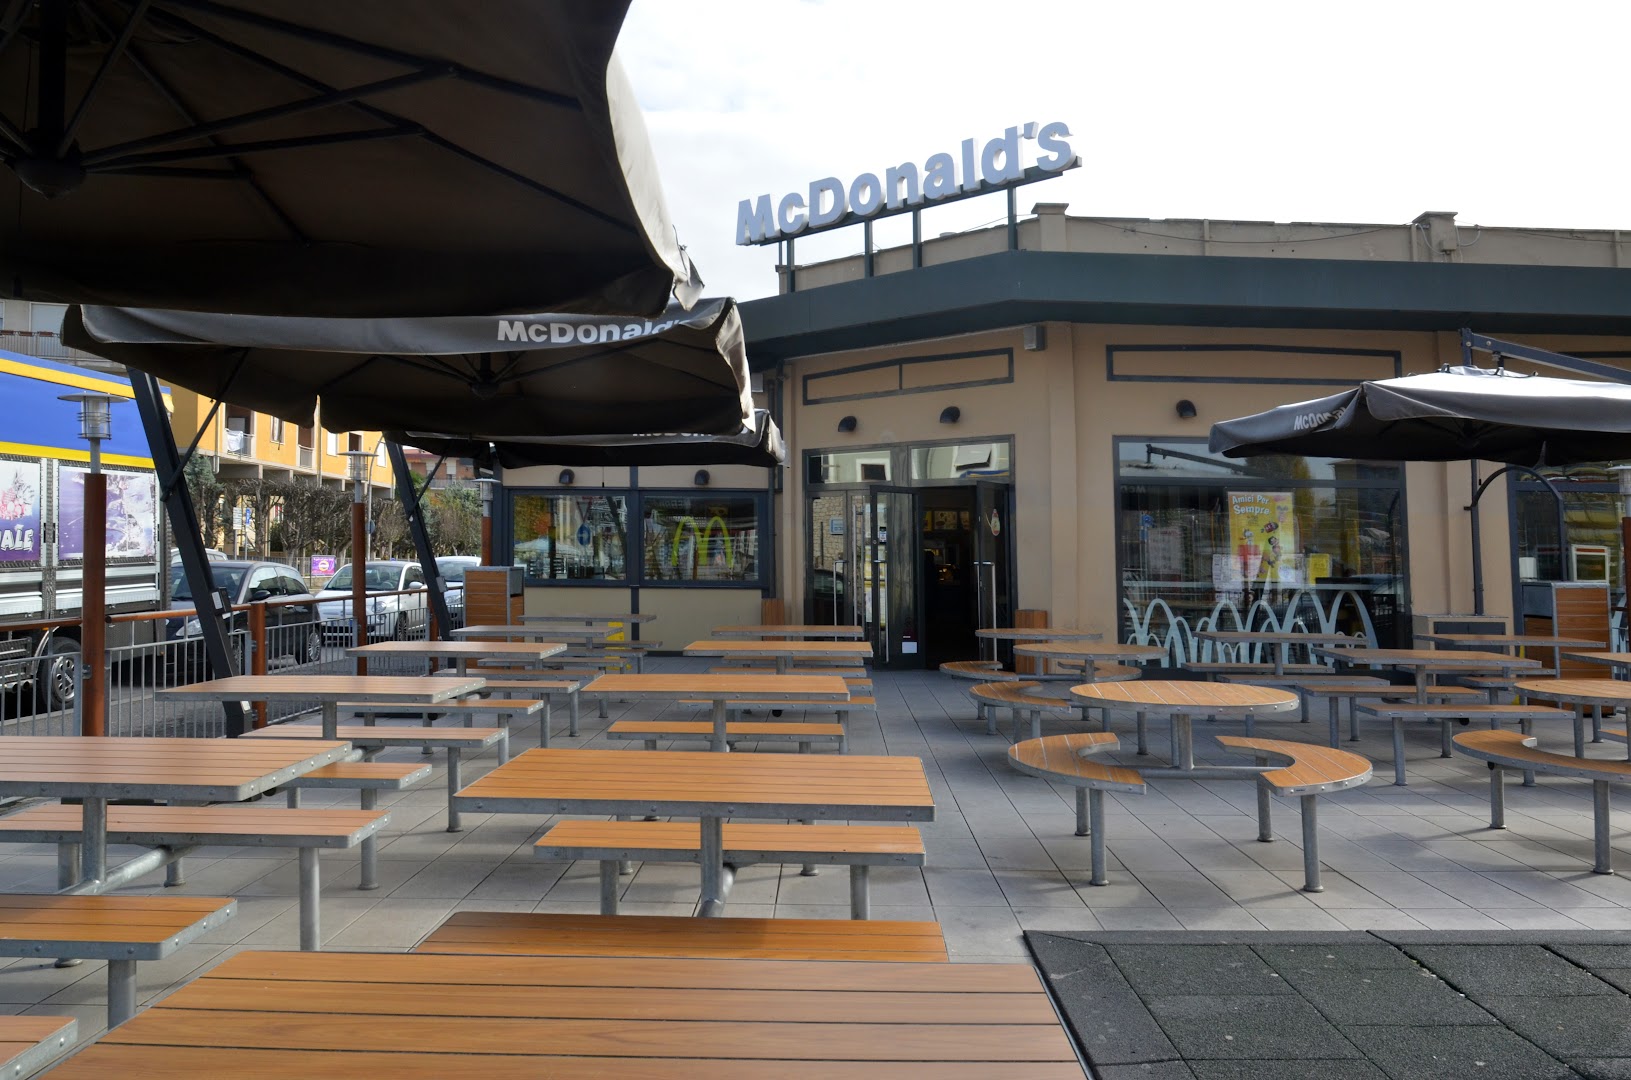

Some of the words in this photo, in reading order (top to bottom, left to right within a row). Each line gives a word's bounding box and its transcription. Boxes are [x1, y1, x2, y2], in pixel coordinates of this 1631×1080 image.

[735, 121, 1075, 246] McDonald's
[1232, 495, 1254, 504] Amici
[1257, 494, 1269, 504] Per
[1233, 504, 1270, 516] Sempre
[0, 526, 34, 551] ALE
